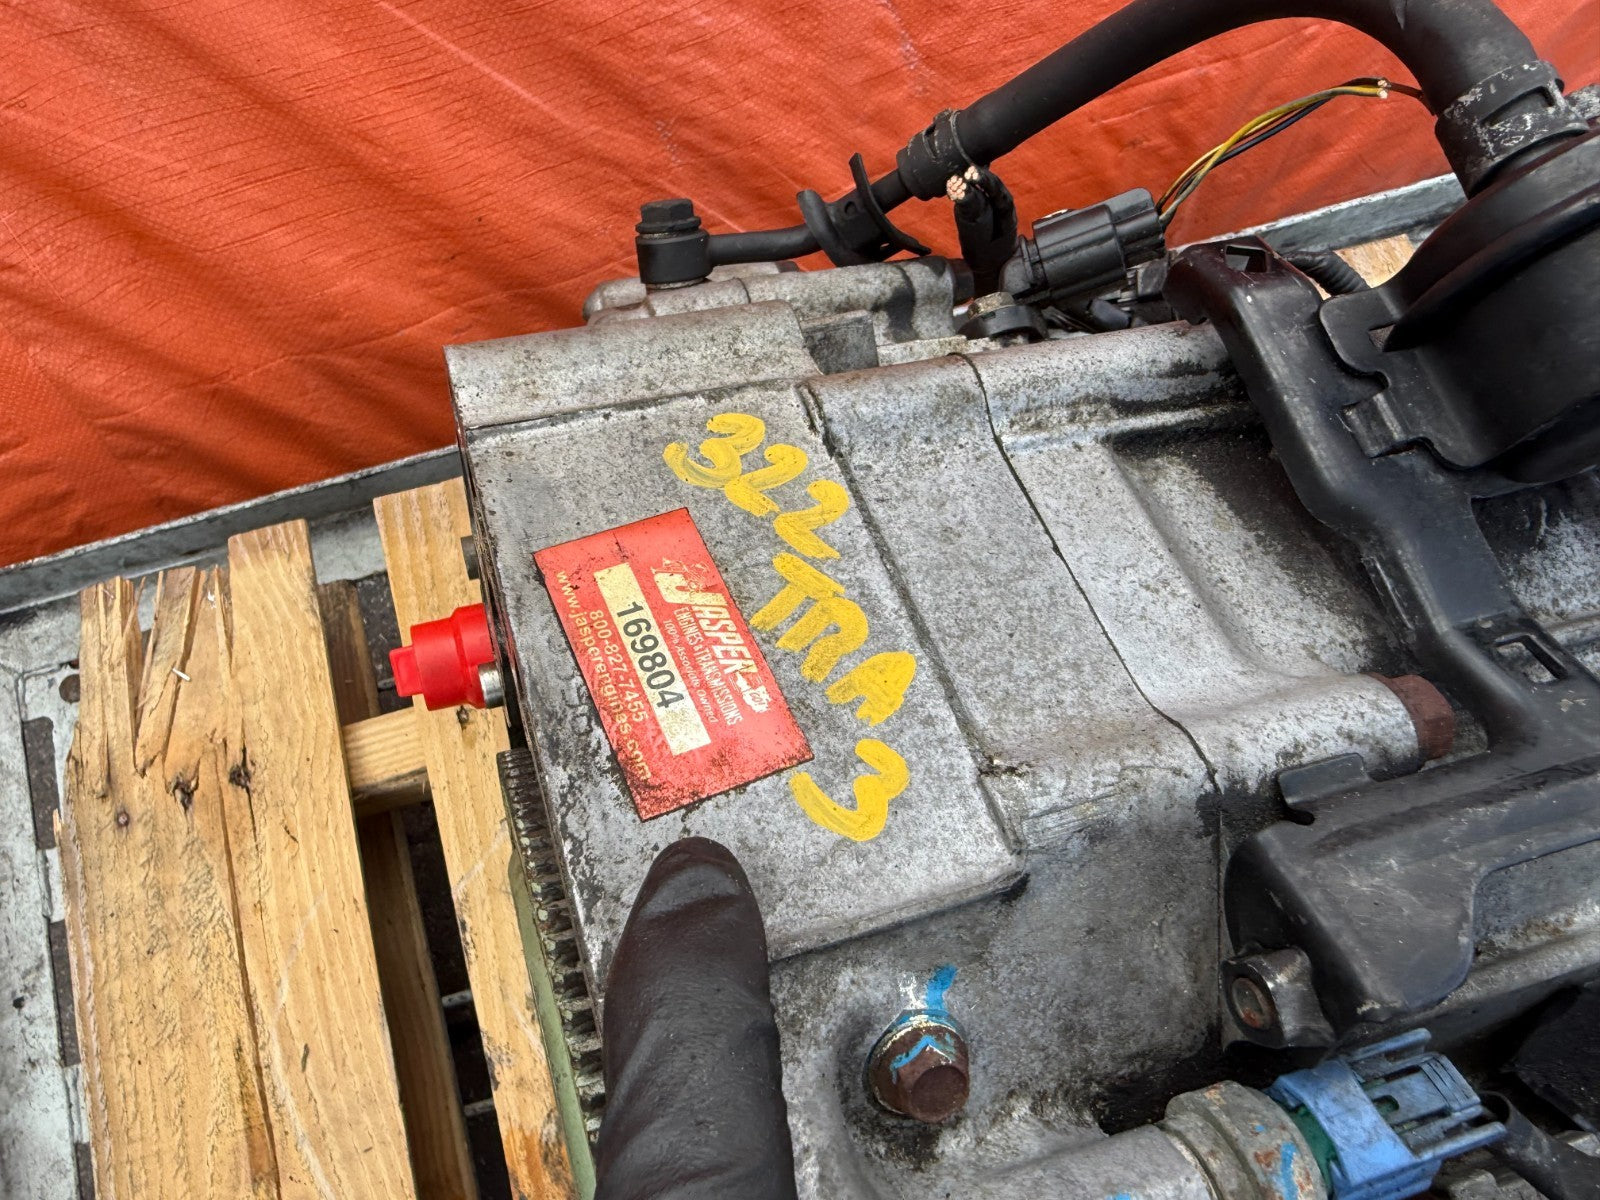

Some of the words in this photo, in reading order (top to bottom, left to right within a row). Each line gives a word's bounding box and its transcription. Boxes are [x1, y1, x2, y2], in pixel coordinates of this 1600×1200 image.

[556, 571, 651, 781] www.jasperengines.com
[588, 608, 648, 724] 800-827-7455
[616, 600, 685, 710] 169804
[654, 573, 758, 677] JASPER
[661, 620, 680, 645] 100%
[674, 644, 701, 688] Associate
[696, 688, 718, 724] Owned
[673, 606, 702, 645] ENGINES
[694, 649, 743, 726] TRANSMISSIONS
